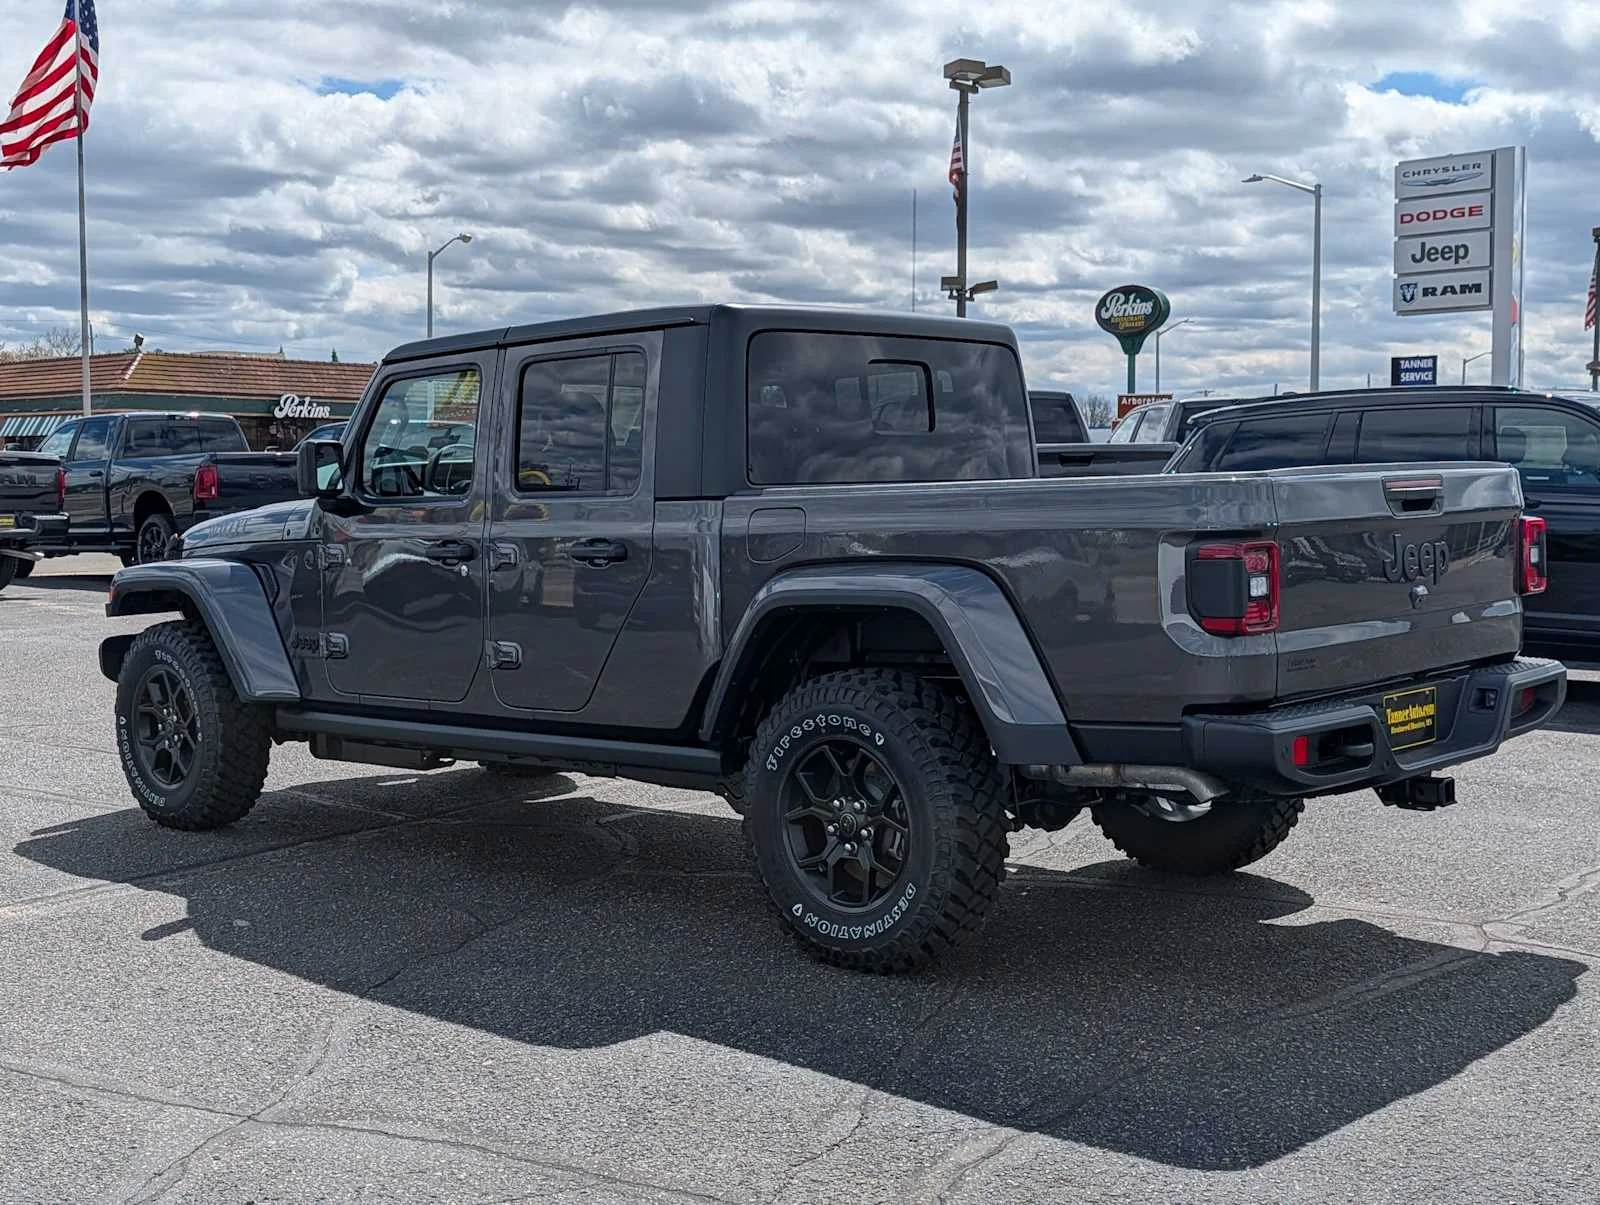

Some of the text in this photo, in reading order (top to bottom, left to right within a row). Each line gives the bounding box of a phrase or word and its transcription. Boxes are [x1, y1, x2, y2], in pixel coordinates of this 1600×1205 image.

[1402, 162, 1482, 178] CHRYSLER
[1400, 205, 1484, 225] DODGE
[1411, 241, 1470, 265] Jeep
[1422, 282, 1482, 298] RAM
[1101, 292, 1154, 320] Perkins
[1400, 359, 1433, 369] TANNER
[1400, 371, 1433, 382] SERVICE
[274, 393, 330, 419] Perkins
[1383, 532, 1450, 586] Jeep
[766, 714, 871, 771] Firestone
[804, 883, 917, 940] DESTINATION
